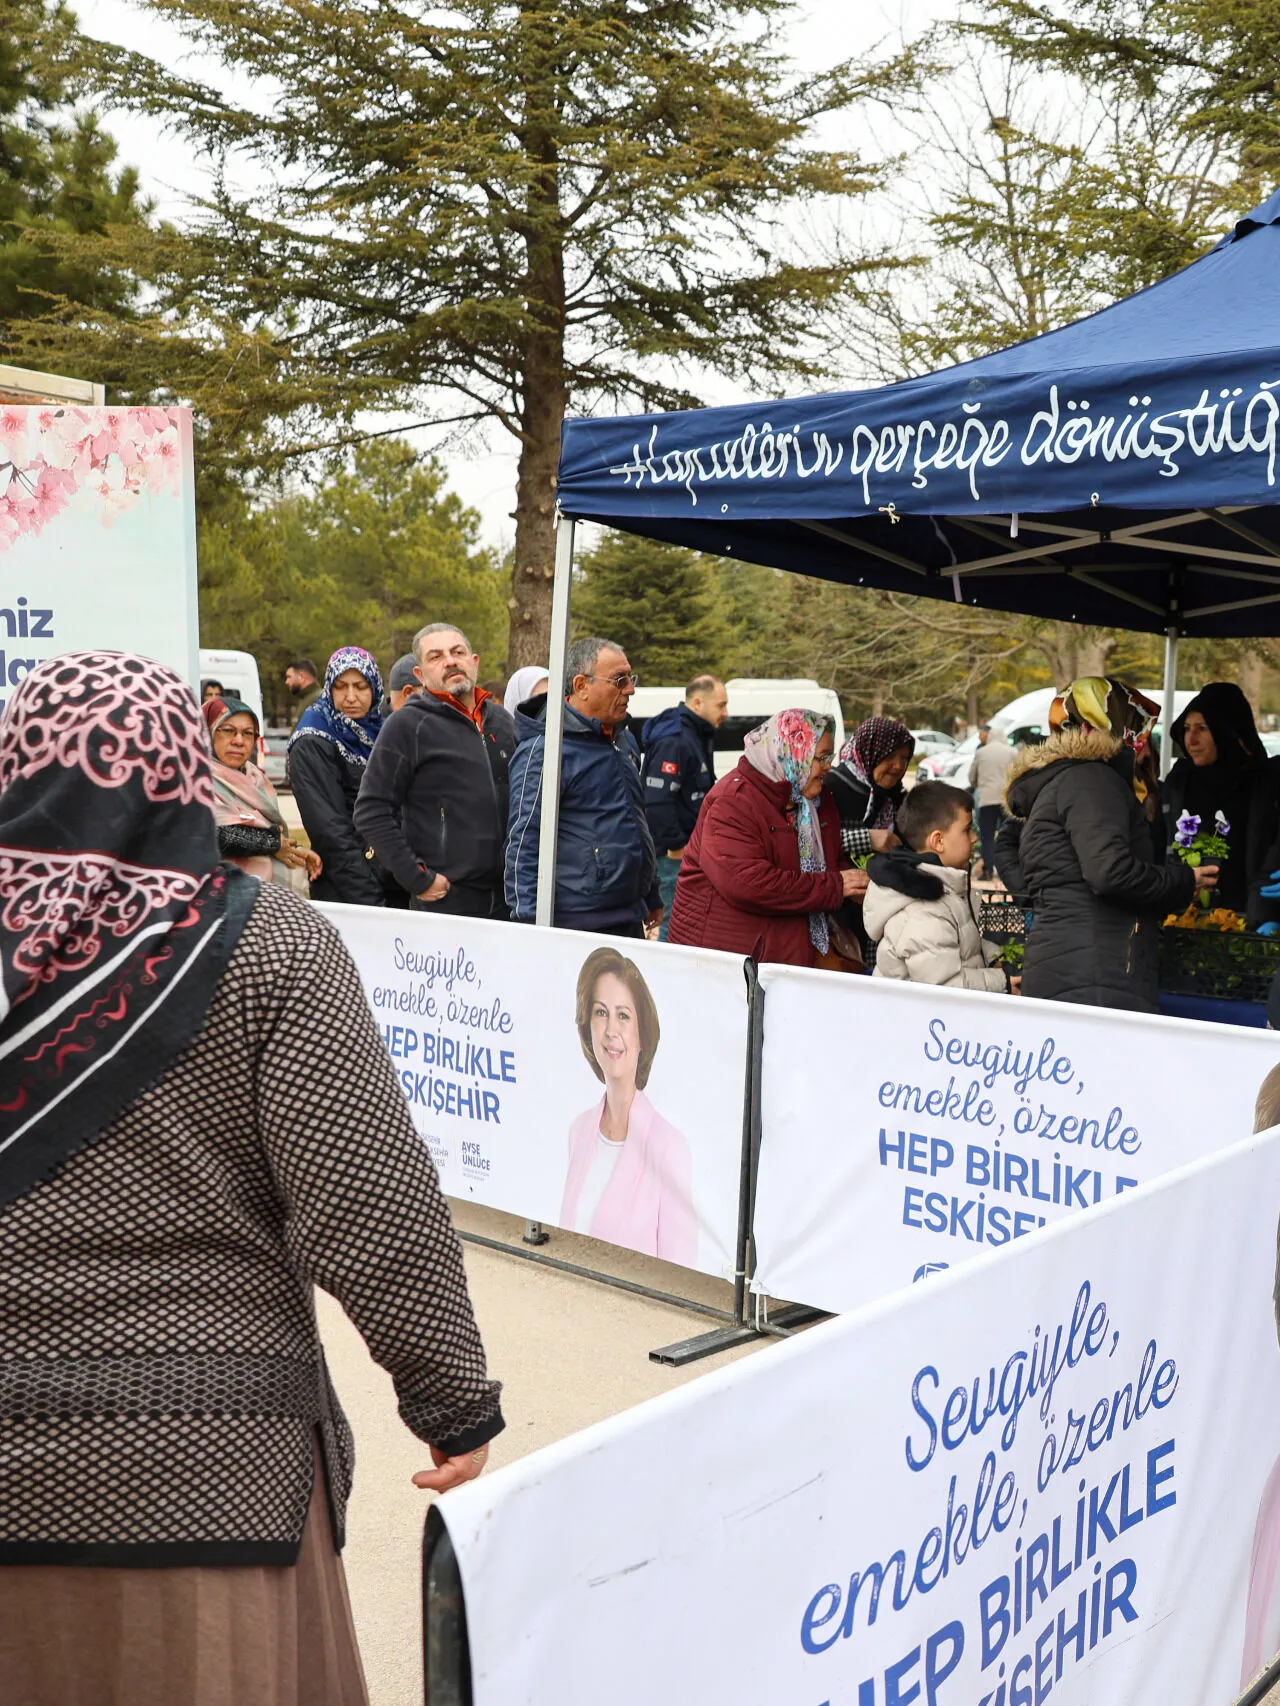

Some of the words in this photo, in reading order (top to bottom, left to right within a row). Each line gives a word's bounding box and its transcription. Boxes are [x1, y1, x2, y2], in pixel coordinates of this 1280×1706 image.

[850, 403, 1013, 505] gerçeğe
[394, 937, 482, 991] Sevgiyle,
[373, 982, 443, 1024] emekle,
[447, 990, 513, 1034] özenle
[423, 1028, 516, 1083] BİRLİKLE
[924, 1019, 1085, 1097] Sevgiyle,
[396, 1068, 501, 1124] SKİŞEHİR
[878, 1077, 1005, 1136] emekle,
[1013, 1095, 1142, 1156] özenle
[878, 1128, 954, 1177] HEP
[904, 1280, 1120, 1473] Sevgiyle,
[800, 1450, 1028, 1655] emekle,
[1037, 1338, 1179, 1491] özenle
[979, 1438, 1178, 1672] BİRLİKLE
